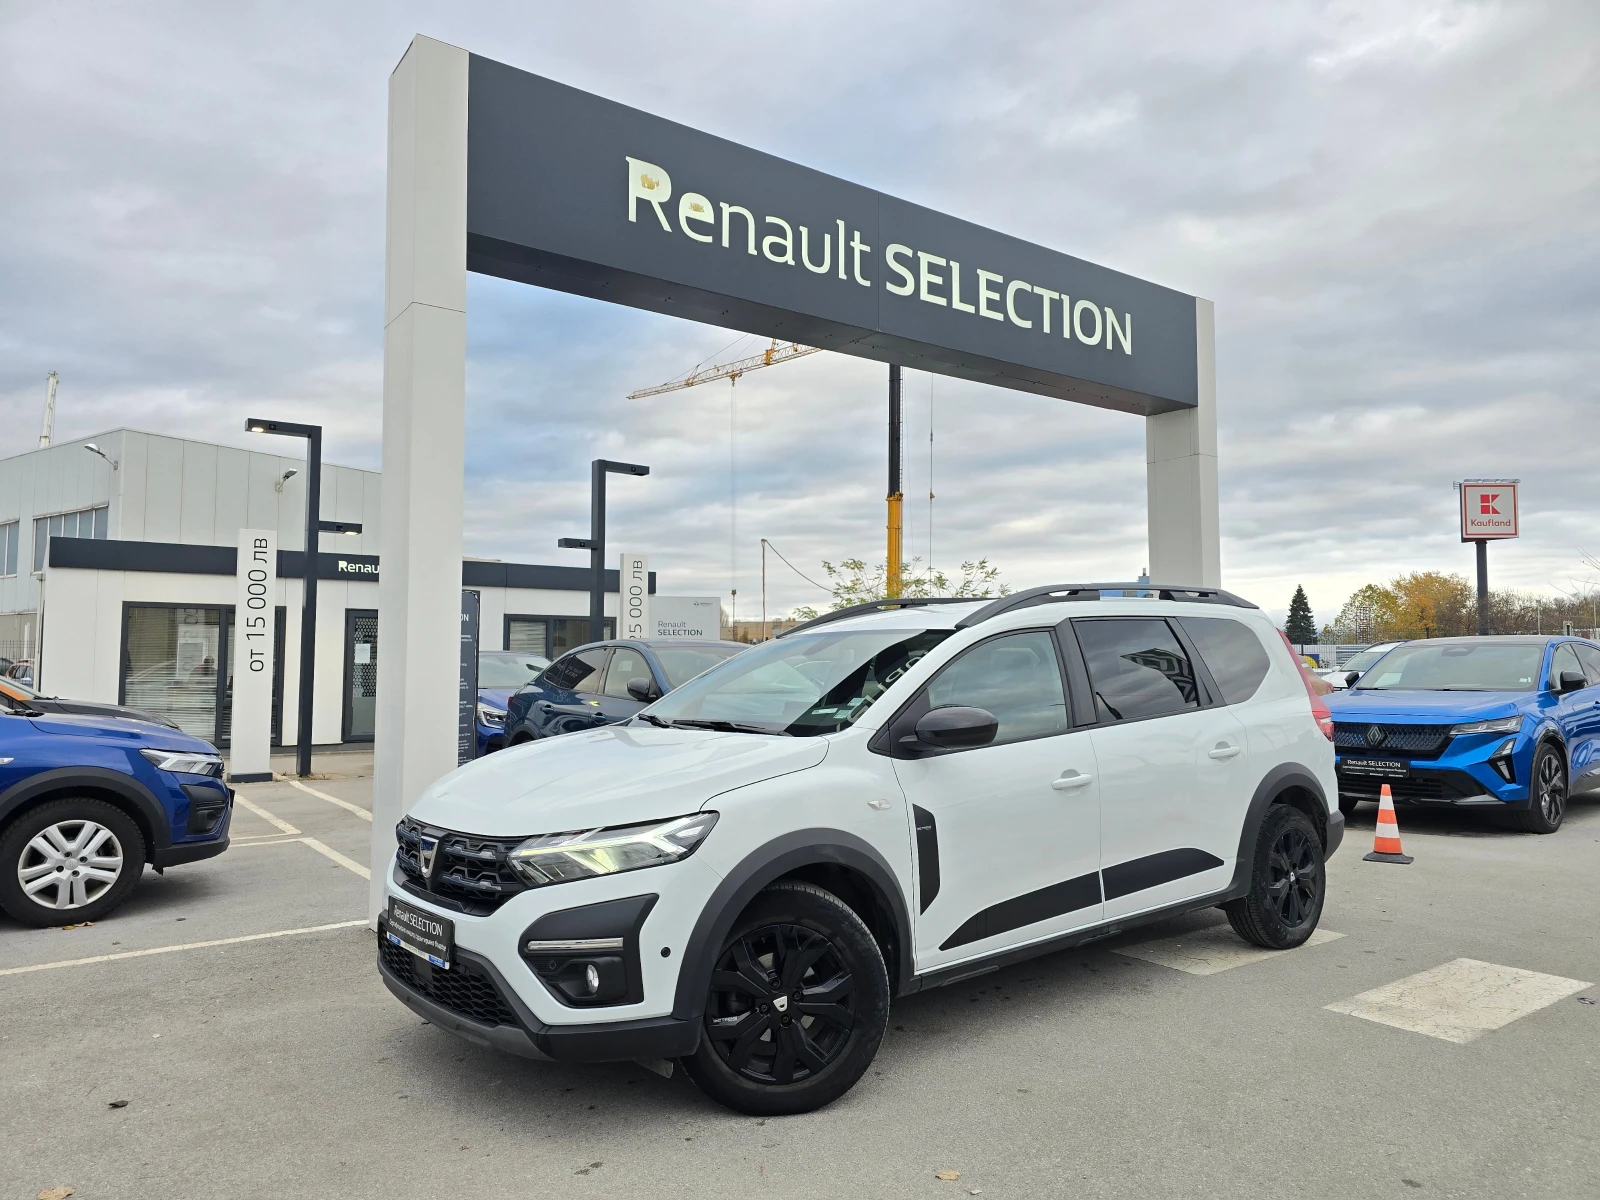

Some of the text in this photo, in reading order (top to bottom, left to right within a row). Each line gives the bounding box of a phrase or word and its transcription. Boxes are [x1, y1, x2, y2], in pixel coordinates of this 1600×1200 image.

[626, 156, 1132, 355] Renault SELECTION
[1471, 519, 1511, 527] Kaufland
[247, 569, 267, 610] 000
[629, 585, 643, 618] 000
[246, 617, 266, 641] 15
[657, 620, 687, 628] Renault
[249, 649, 264, 672] от
[394, 905, 410, 924] Renault
[410, 913, 443, 936] SELECTION
